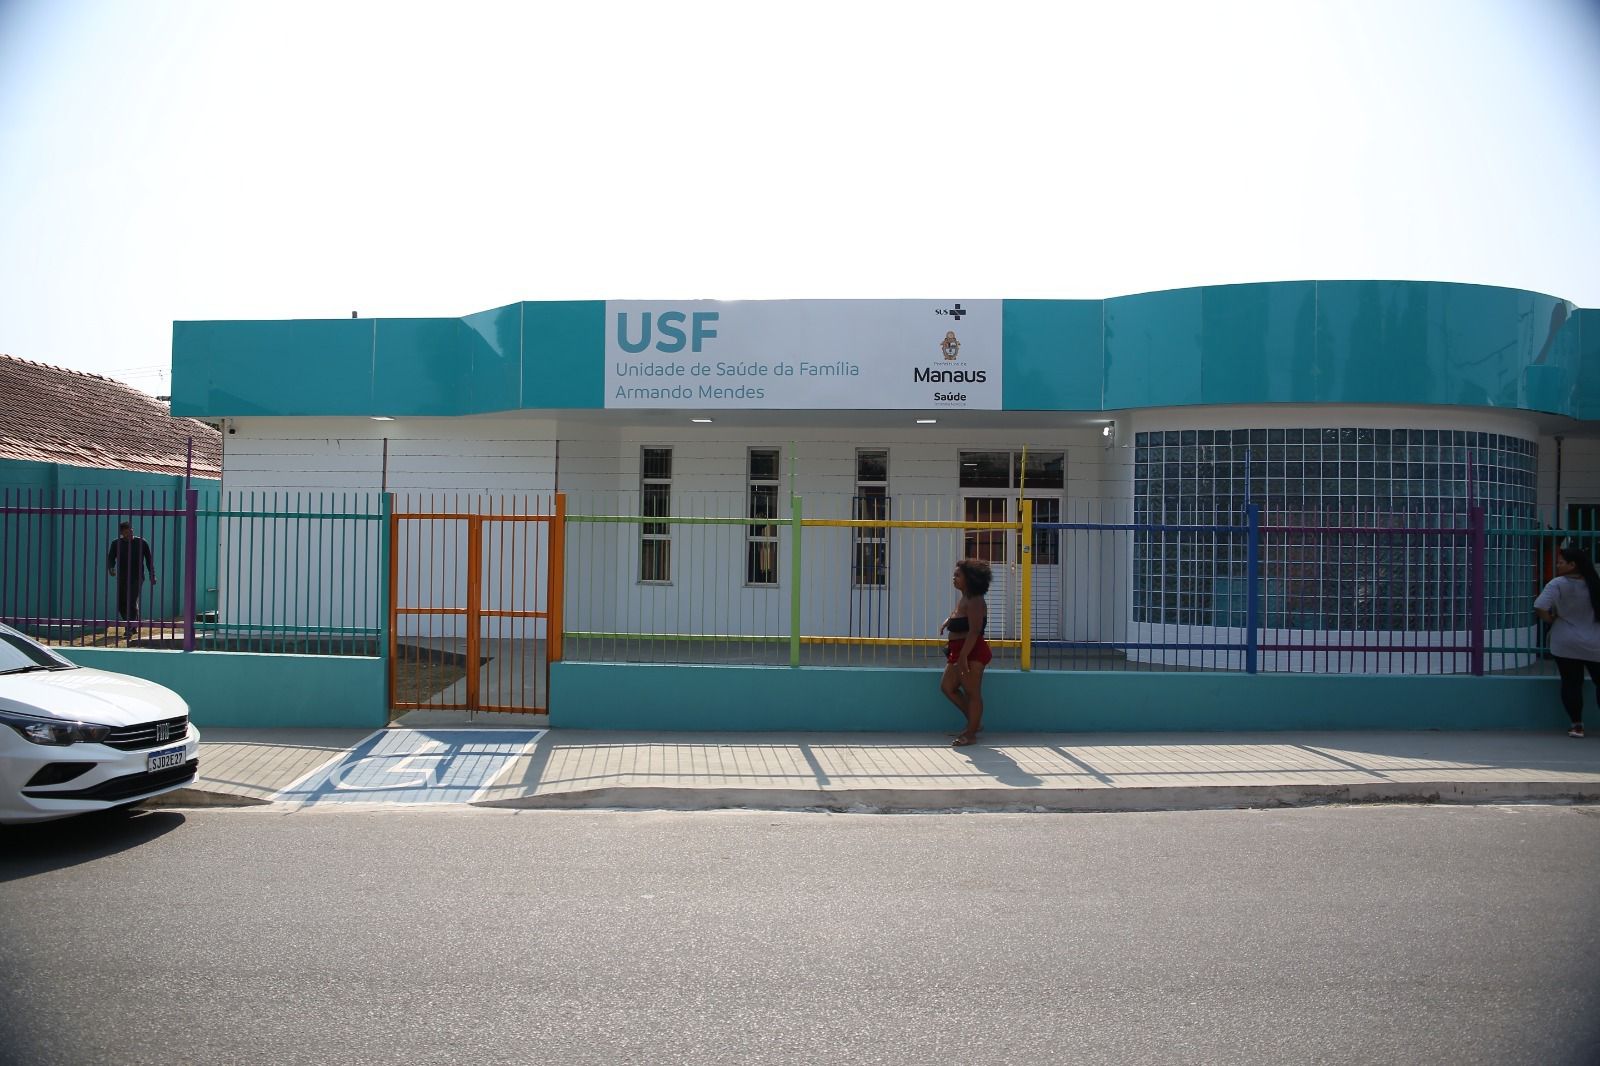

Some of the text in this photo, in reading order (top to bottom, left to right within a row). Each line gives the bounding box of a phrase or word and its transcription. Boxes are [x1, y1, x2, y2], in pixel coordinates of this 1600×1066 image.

[617, 311, 720, 354] USF
[616, 361, 860, 377] Unidade de Saúde da Família
[914, 367, 986, 383] Manaus
[615, 384, 765, 399] Armando Mendes
[934, 391, 967, 401] Saúde
[152, 753, 183, 769] SJD2E27
